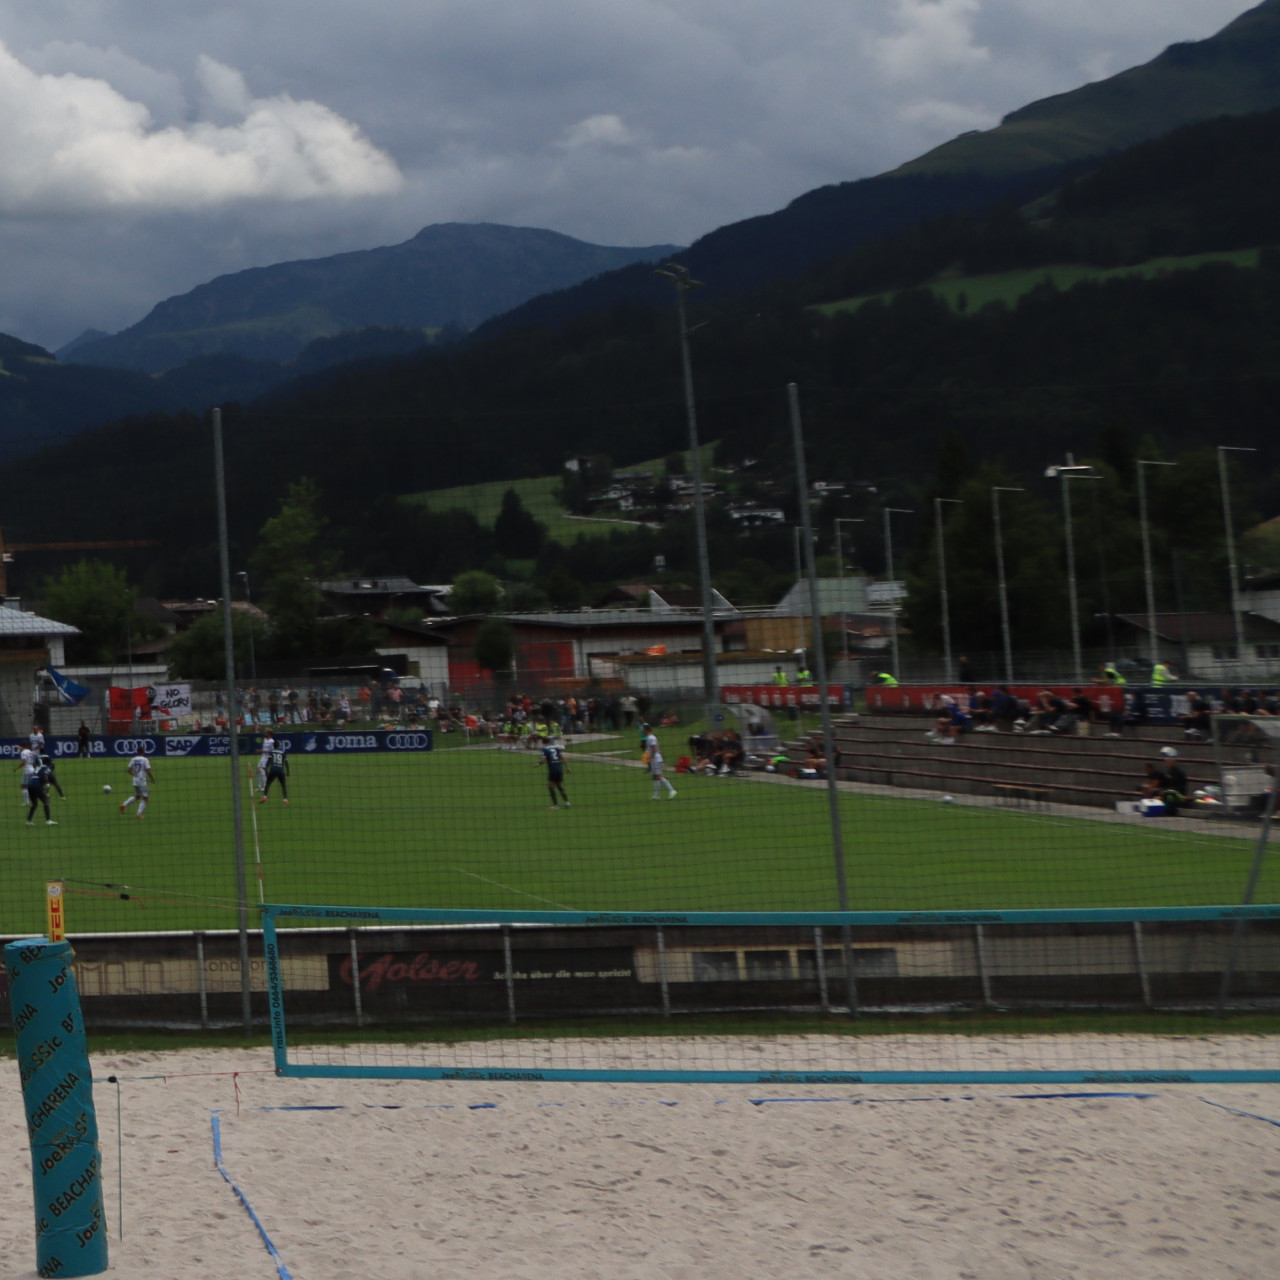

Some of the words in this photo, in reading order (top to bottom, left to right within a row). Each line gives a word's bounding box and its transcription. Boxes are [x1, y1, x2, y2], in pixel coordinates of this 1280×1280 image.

[166, 688, 179, 698] NO
[160, 696, 189, 709] GLORY
[166, 739, 192, 753] SAP
[326, 735, 378, 750] joma
[272, 753, 283, 764] 19
